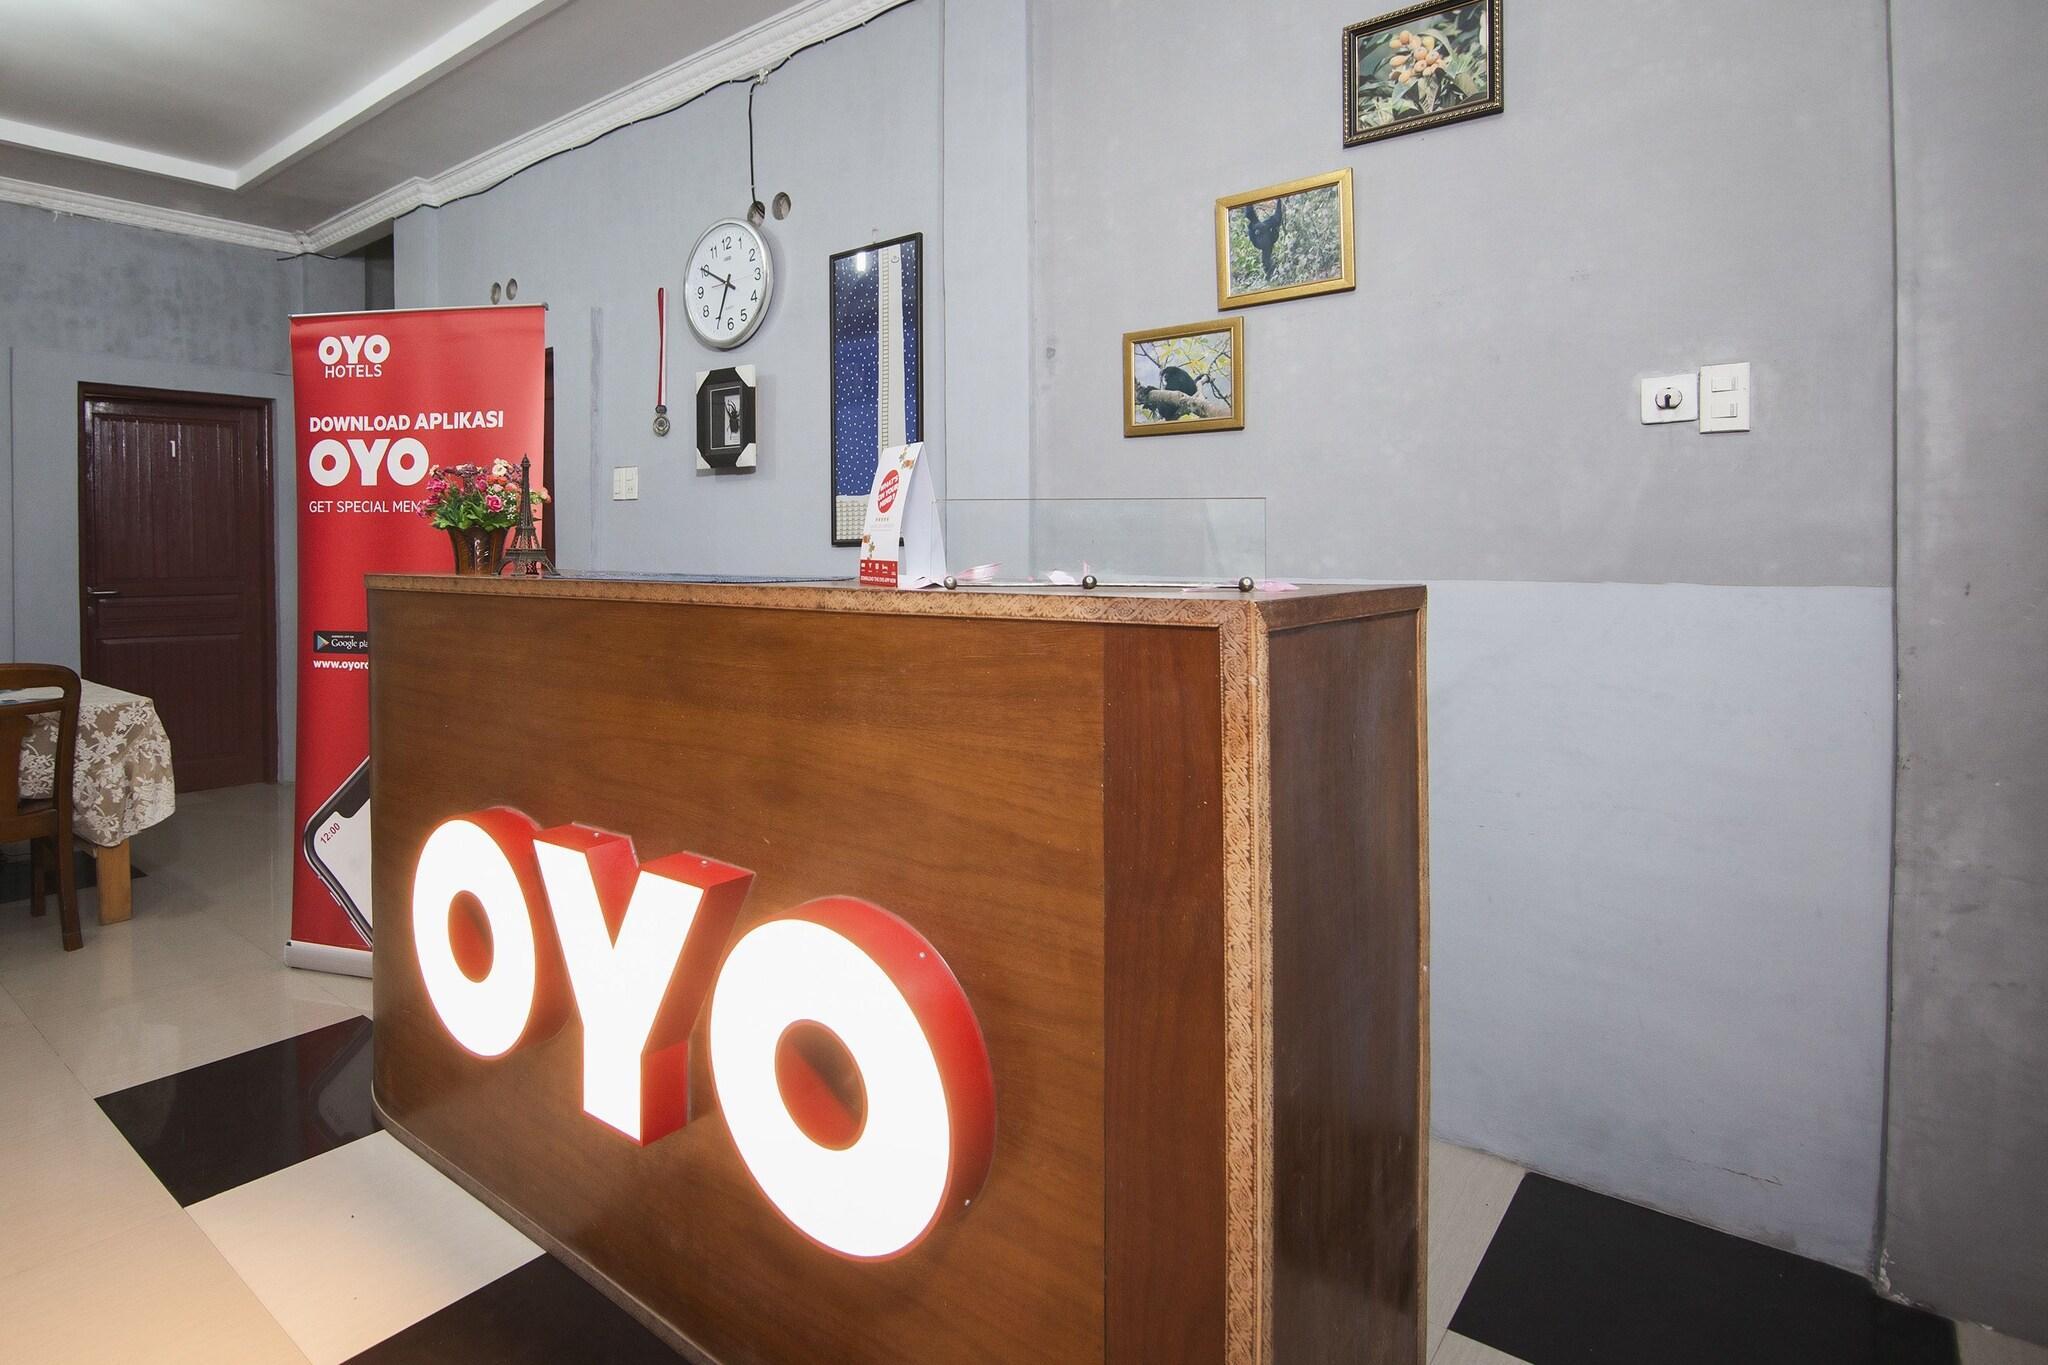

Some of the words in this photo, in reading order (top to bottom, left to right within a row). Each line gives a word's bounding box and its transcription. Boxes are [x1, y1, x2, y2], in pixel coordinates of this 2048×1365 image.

[721, 236, 732, 251] 12
[738, 237, 743, 249] 1
[710, 246, 718, 259] 11
[748, 248, 756, 262] 2
[754, 267, 761, 281] 3
[697, 286, 704, 299] 9
[750, 289, 758, 302] 4
[702, 305, 710, 318] 8
[740, 308, 748, 322] 5
[727, 317, 735, 331] 6
[318, 334, 391, 365] OYO
[324, 364, 382, 379] HOTELS
[309, 414, 411, 433] DOWNLOAD
[414, 410, 504, 430] APLIKASI
[169, 440, 176, 458] 1
[308, 437, 430, 487] OYO
[309, 500, 332, 513] GET
[336, 500, 390, 513] SPECIAL
[331, 638, 358, 650] Google
[320, 822, 341, 844] 12:00
[412, 806, 998, 1261] OYO
